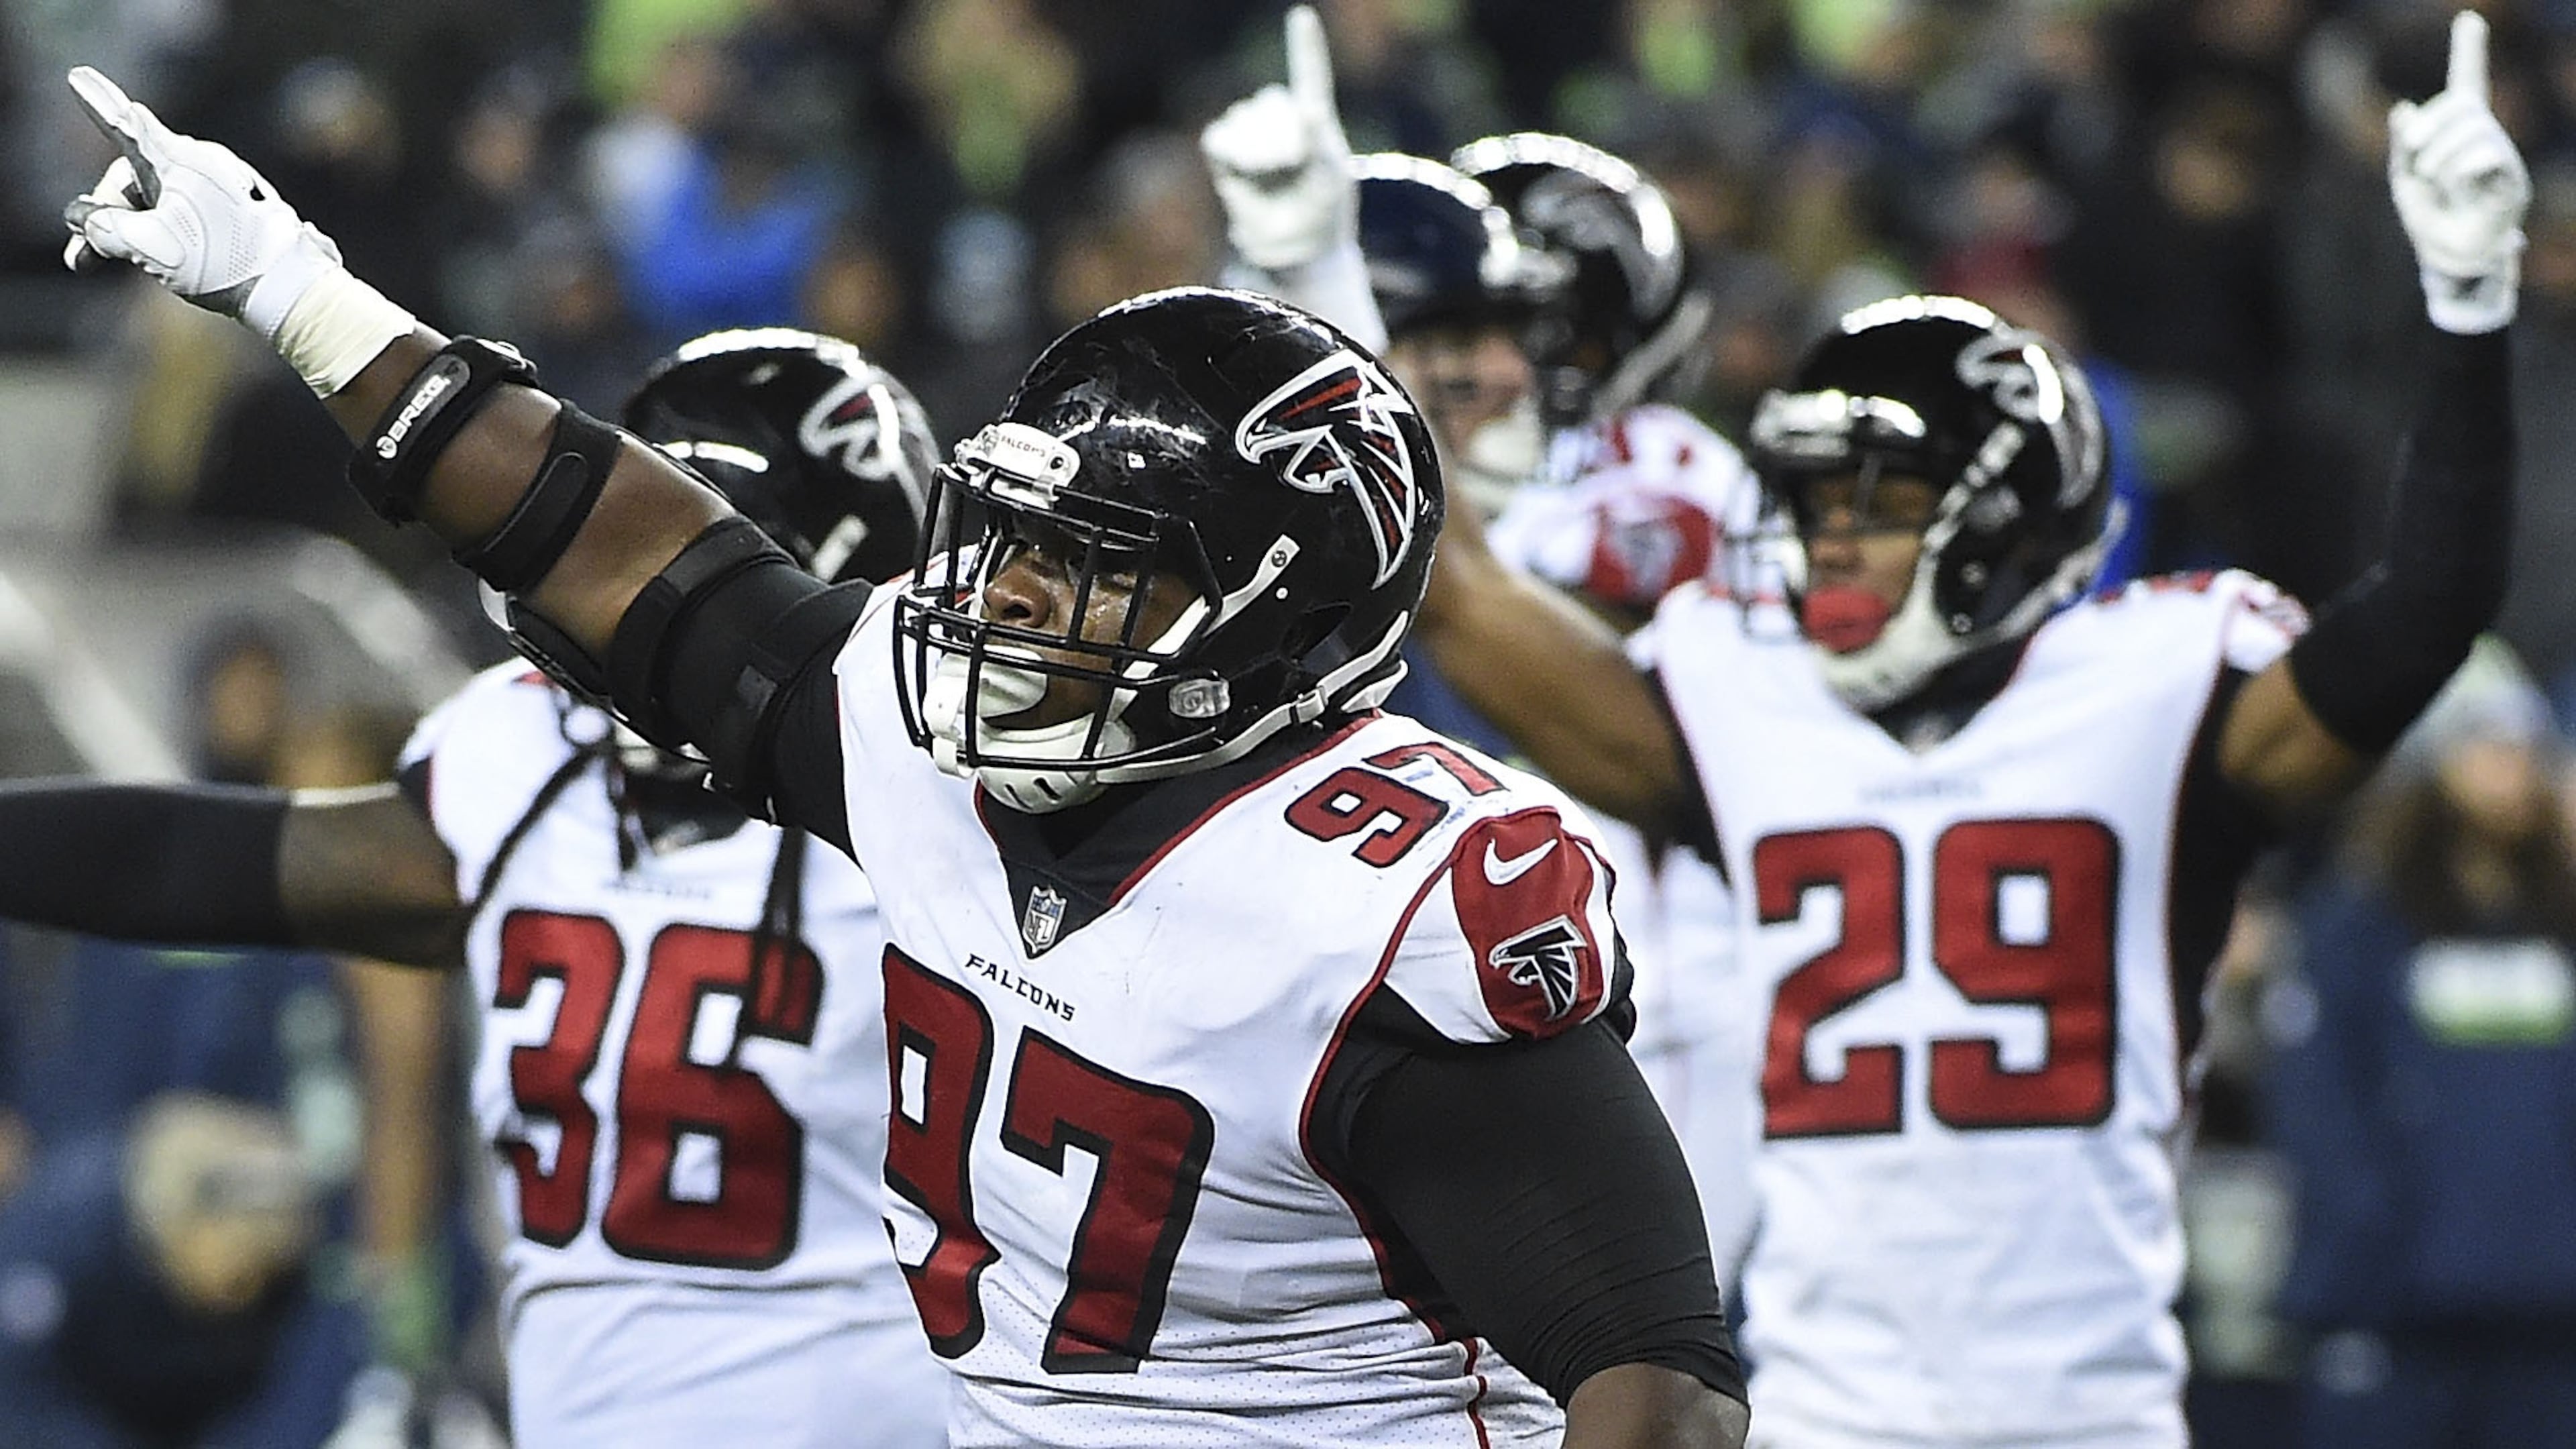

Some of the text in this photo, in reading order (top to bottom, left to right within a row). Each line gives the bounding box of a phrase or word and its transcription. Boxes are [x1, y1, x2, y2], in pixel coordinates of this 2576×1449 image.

[1284, 741, 1511, 869] 97
[493, 908, 825, 1271] 36
[965, 953, 1075, 1022] FALCONS
[1752, 816, 2120, 1140] 29
[881, 943, 1215, 1375] 97
